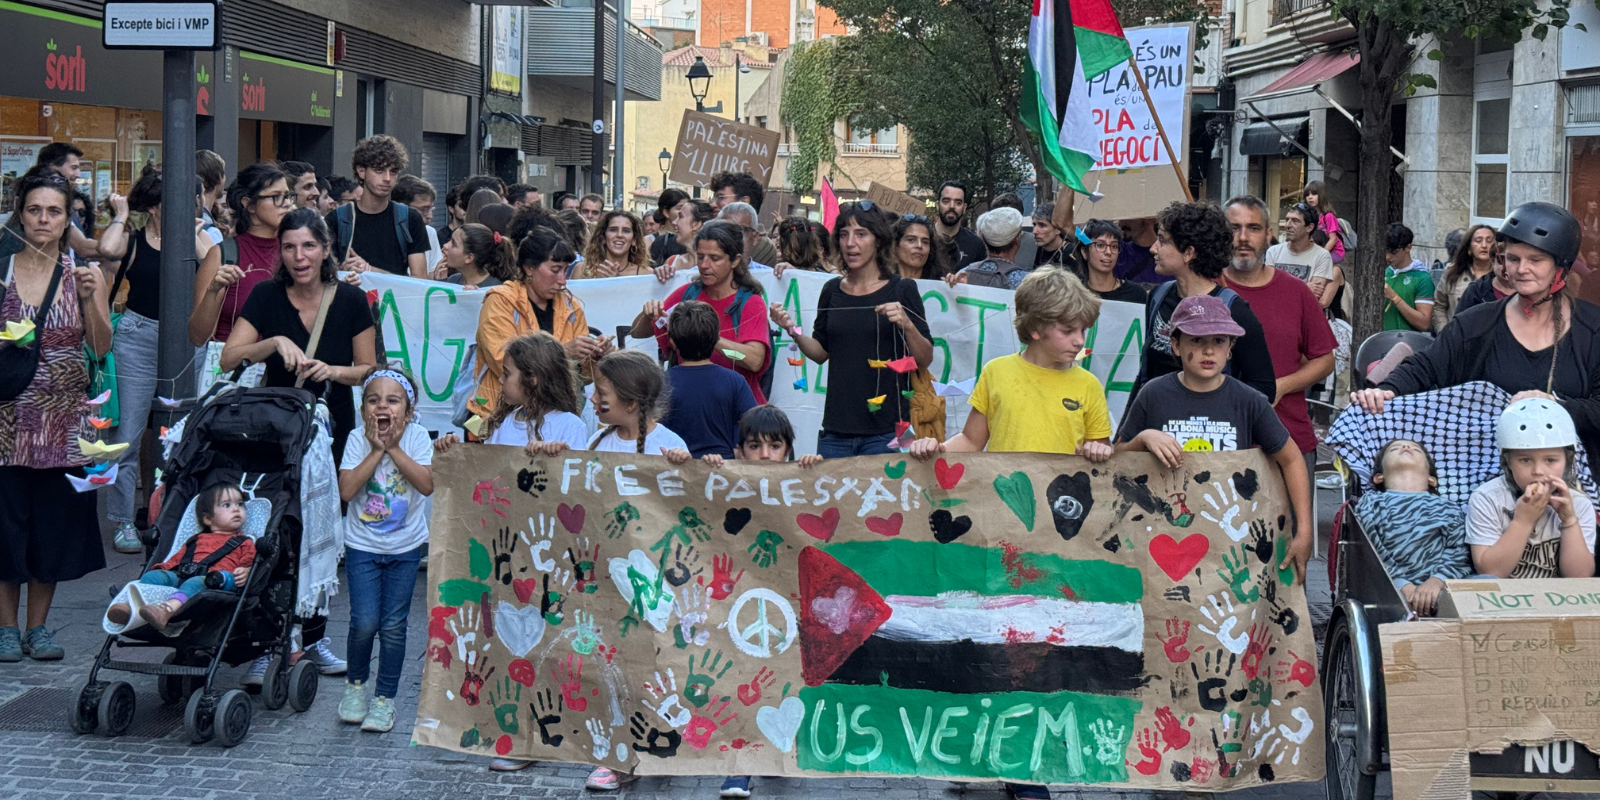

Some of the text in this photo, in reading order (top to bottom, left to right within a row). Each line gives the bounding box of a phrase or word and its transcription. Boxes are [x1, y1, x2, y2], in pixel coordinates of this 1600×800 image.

[111, 17, 209, 32] Excepte bici i VMP
[1160, 45, 1181, 59] UN
[45, 45, 86, 92] sorli
[1143, 63, 1183, 90] PAU
[242, 77, 266, 111] sorli
[1181, 425, 1204, 433] BONA
[561, 458, 686, 497] FREE
[1476, 592, 1534, 610] NOT
[811, 699, 883, 765] US
